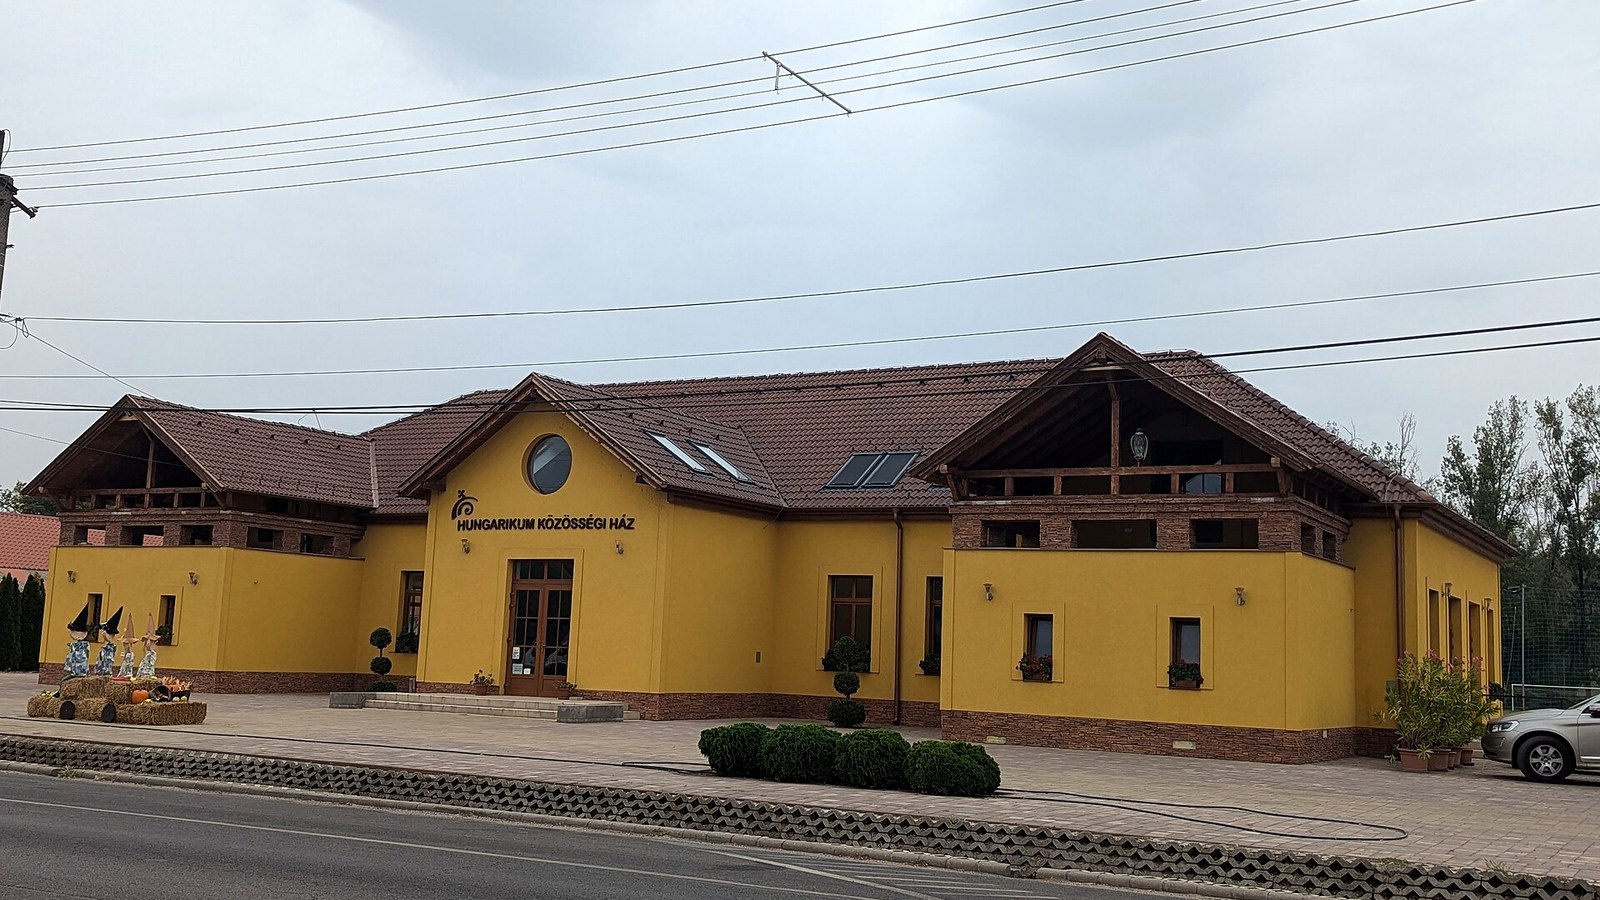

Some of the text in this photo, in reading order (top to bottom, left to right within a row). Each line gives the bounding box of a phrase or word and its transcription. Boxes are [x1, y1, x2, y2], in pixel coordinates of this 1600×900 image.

[457, 514, 635, 531] HUNGARIKUM KÖZÖSSÉGI HÁZ
